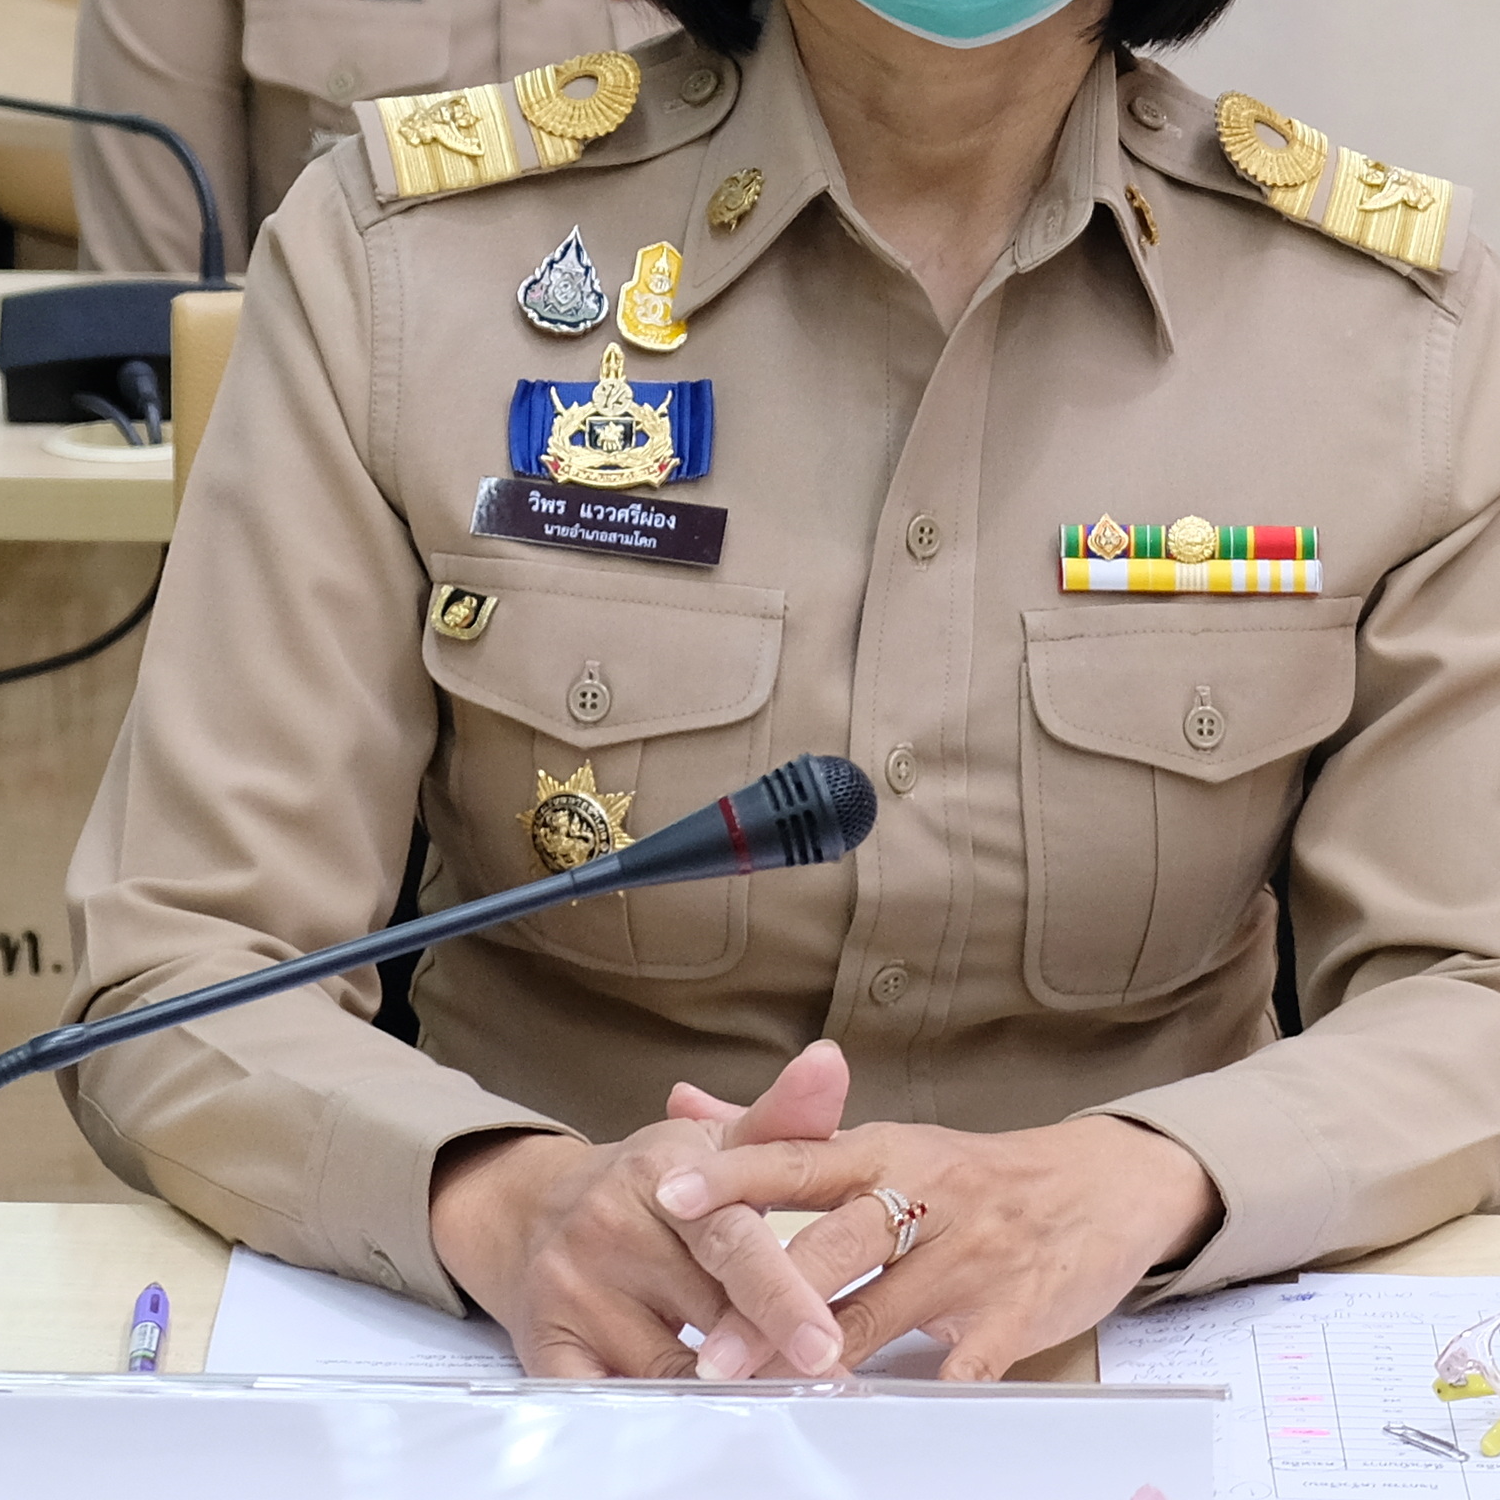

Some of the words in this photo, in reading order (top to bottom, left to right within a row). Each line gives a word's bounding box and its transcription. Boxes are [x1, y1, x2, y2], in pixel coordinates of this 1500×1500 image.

[528, 490, 567, 516] วิพร
[543, 522, 658, 549] นายอำเภอสามโคก
